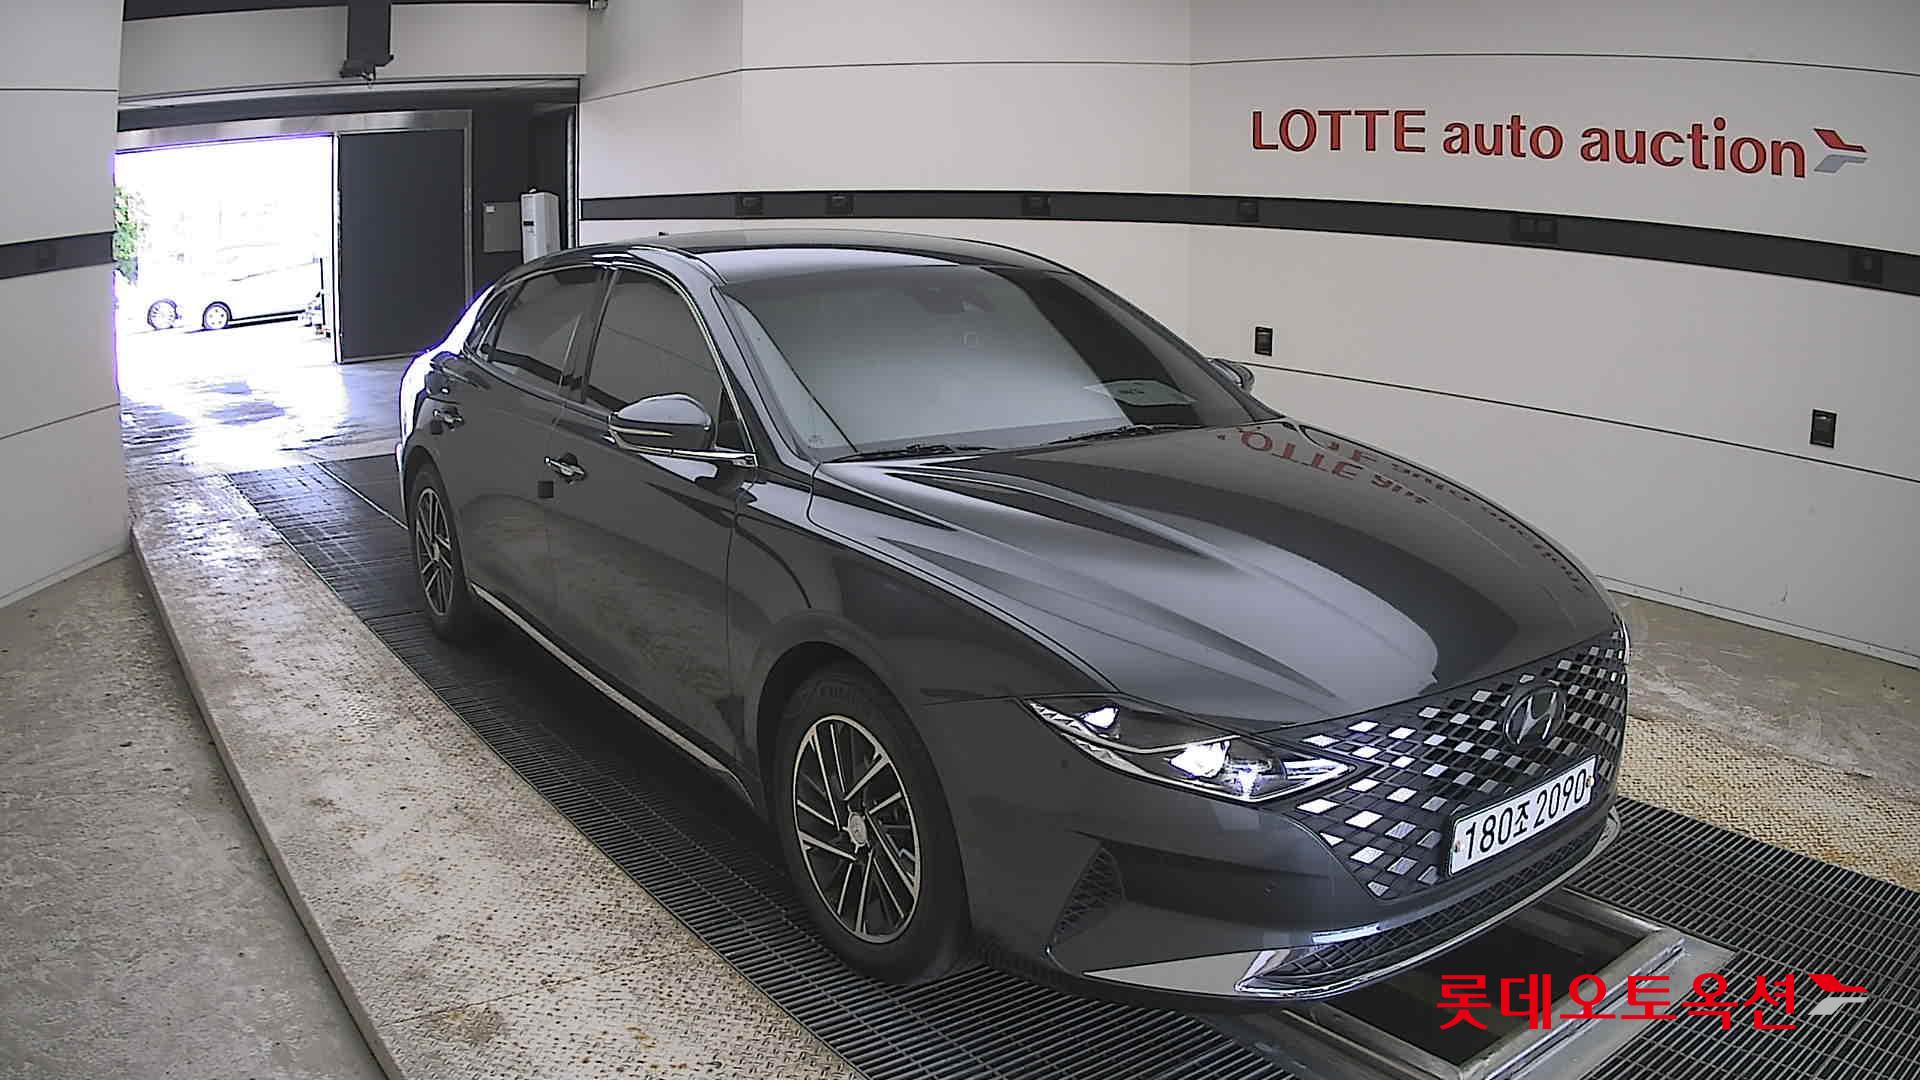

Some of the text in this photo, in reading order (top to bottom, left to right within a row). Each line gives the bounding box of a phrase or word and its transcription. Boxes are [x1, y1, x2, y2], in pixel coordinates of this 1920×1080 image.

[1252, 109, 1808, 178] LOTTE auto auction
[1534, 768, 1587, 829] 2090
